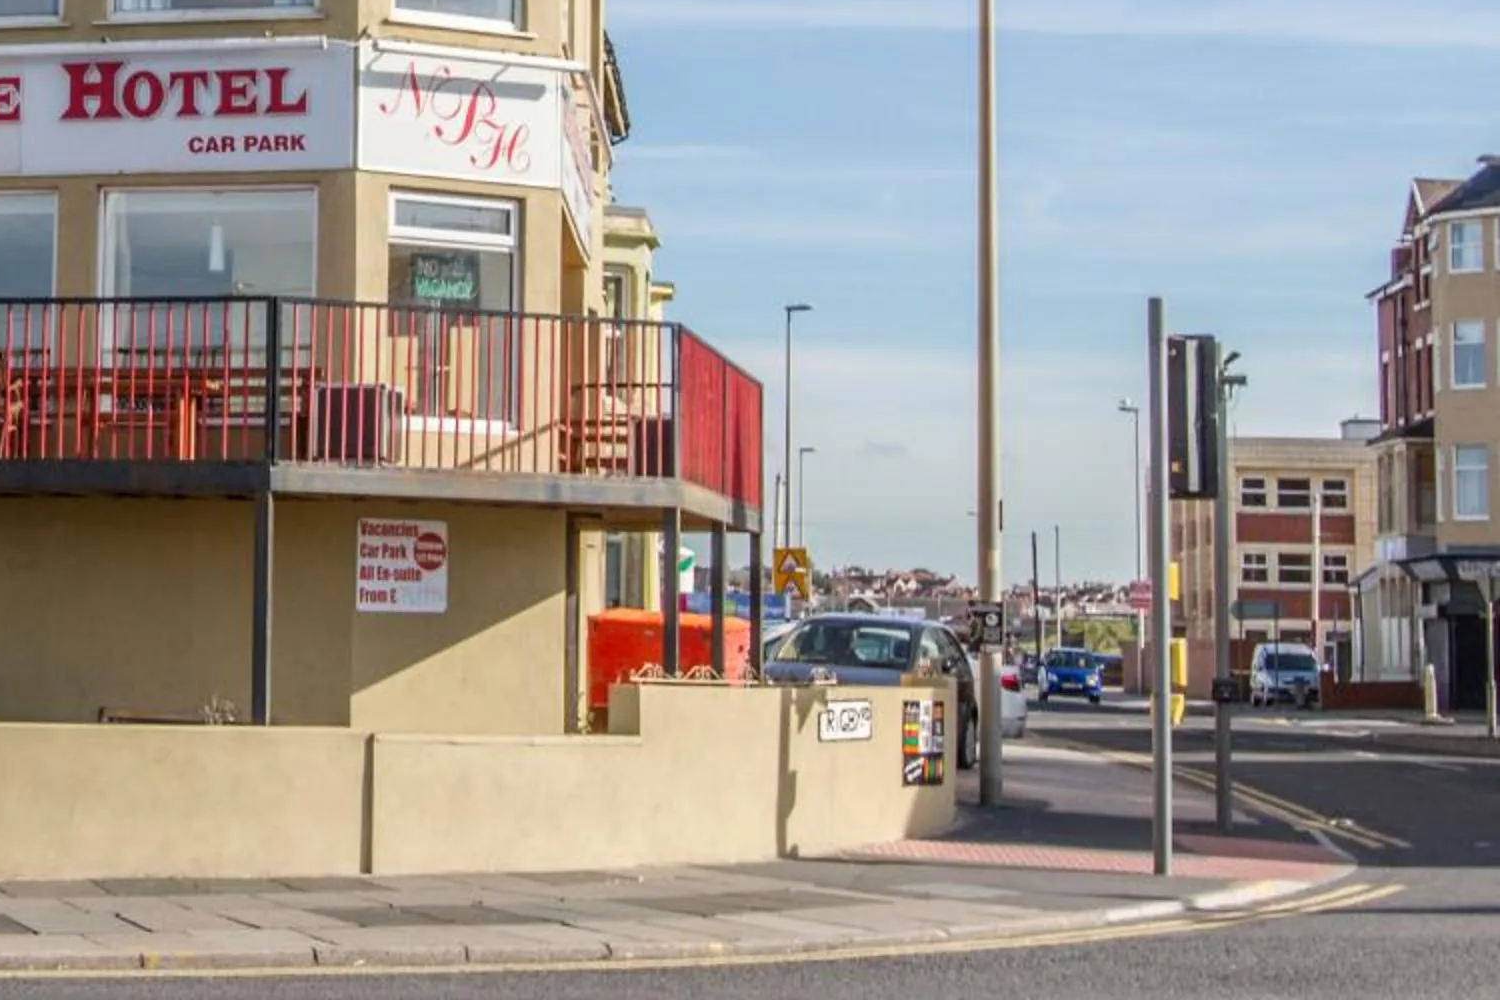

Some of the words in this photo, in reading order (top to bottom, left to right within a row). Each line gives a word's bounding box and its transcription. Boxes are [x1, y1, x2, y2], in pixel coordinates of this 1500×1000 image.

[60, 60, 308, 123] HOTEL
[188, 135, 236, 155] CAR
[244, 134, 306, 153] PARK
